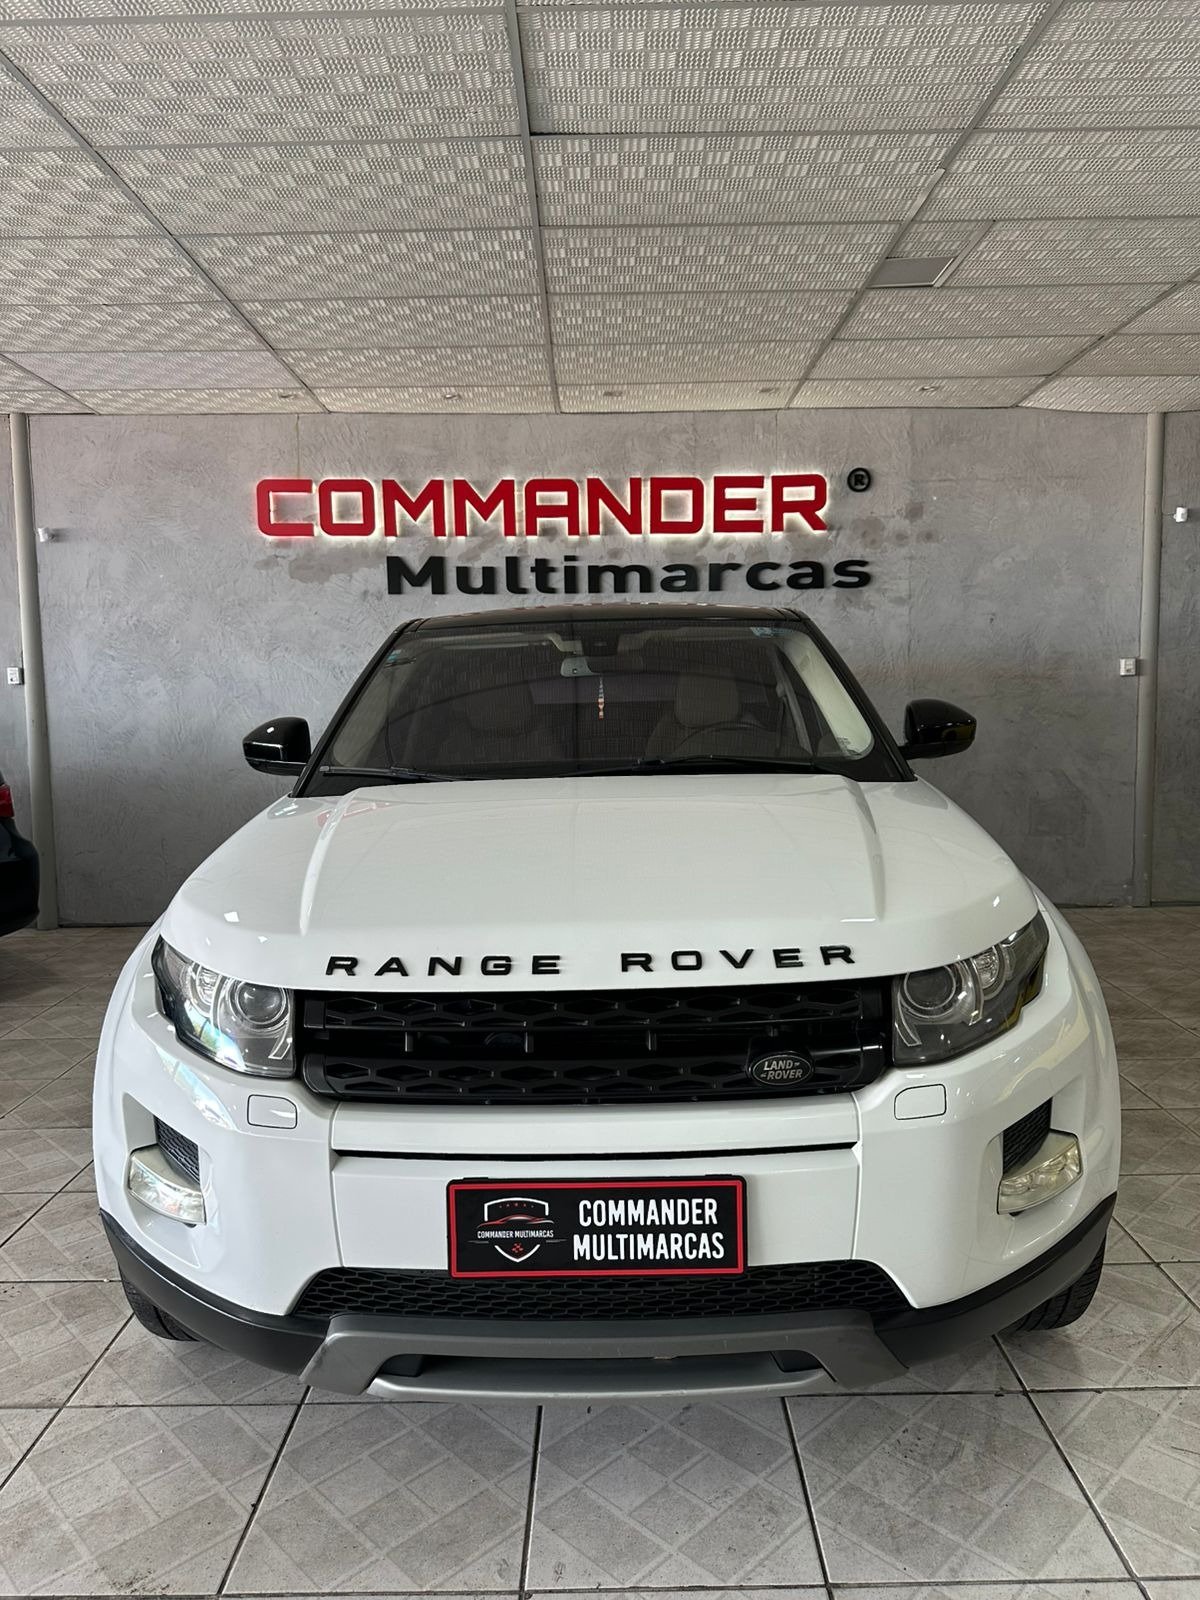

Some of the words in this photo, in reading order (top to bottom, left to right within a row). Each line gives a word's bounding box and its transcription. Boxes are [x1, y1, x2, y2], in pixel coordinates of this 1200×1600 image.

[256, 474, 828, 537] COMMANDER
[386, 555, 872, 595] Multimarcas
[325, 955, 561, 977] RANGE
[620, 945, 856, 973] ROVER
[763, 1060, 793, 1071] LAND
[766, 1068, 803, 1080] ROVER
[578, 1198, 719, 1227] COMMANDER
[477, 1230, 514, 1239] COMMANDER
[514, 1229, 554, 1238] MULTIMARCAS
[573, 1232, 725, 1261] MULTIMARCAS
